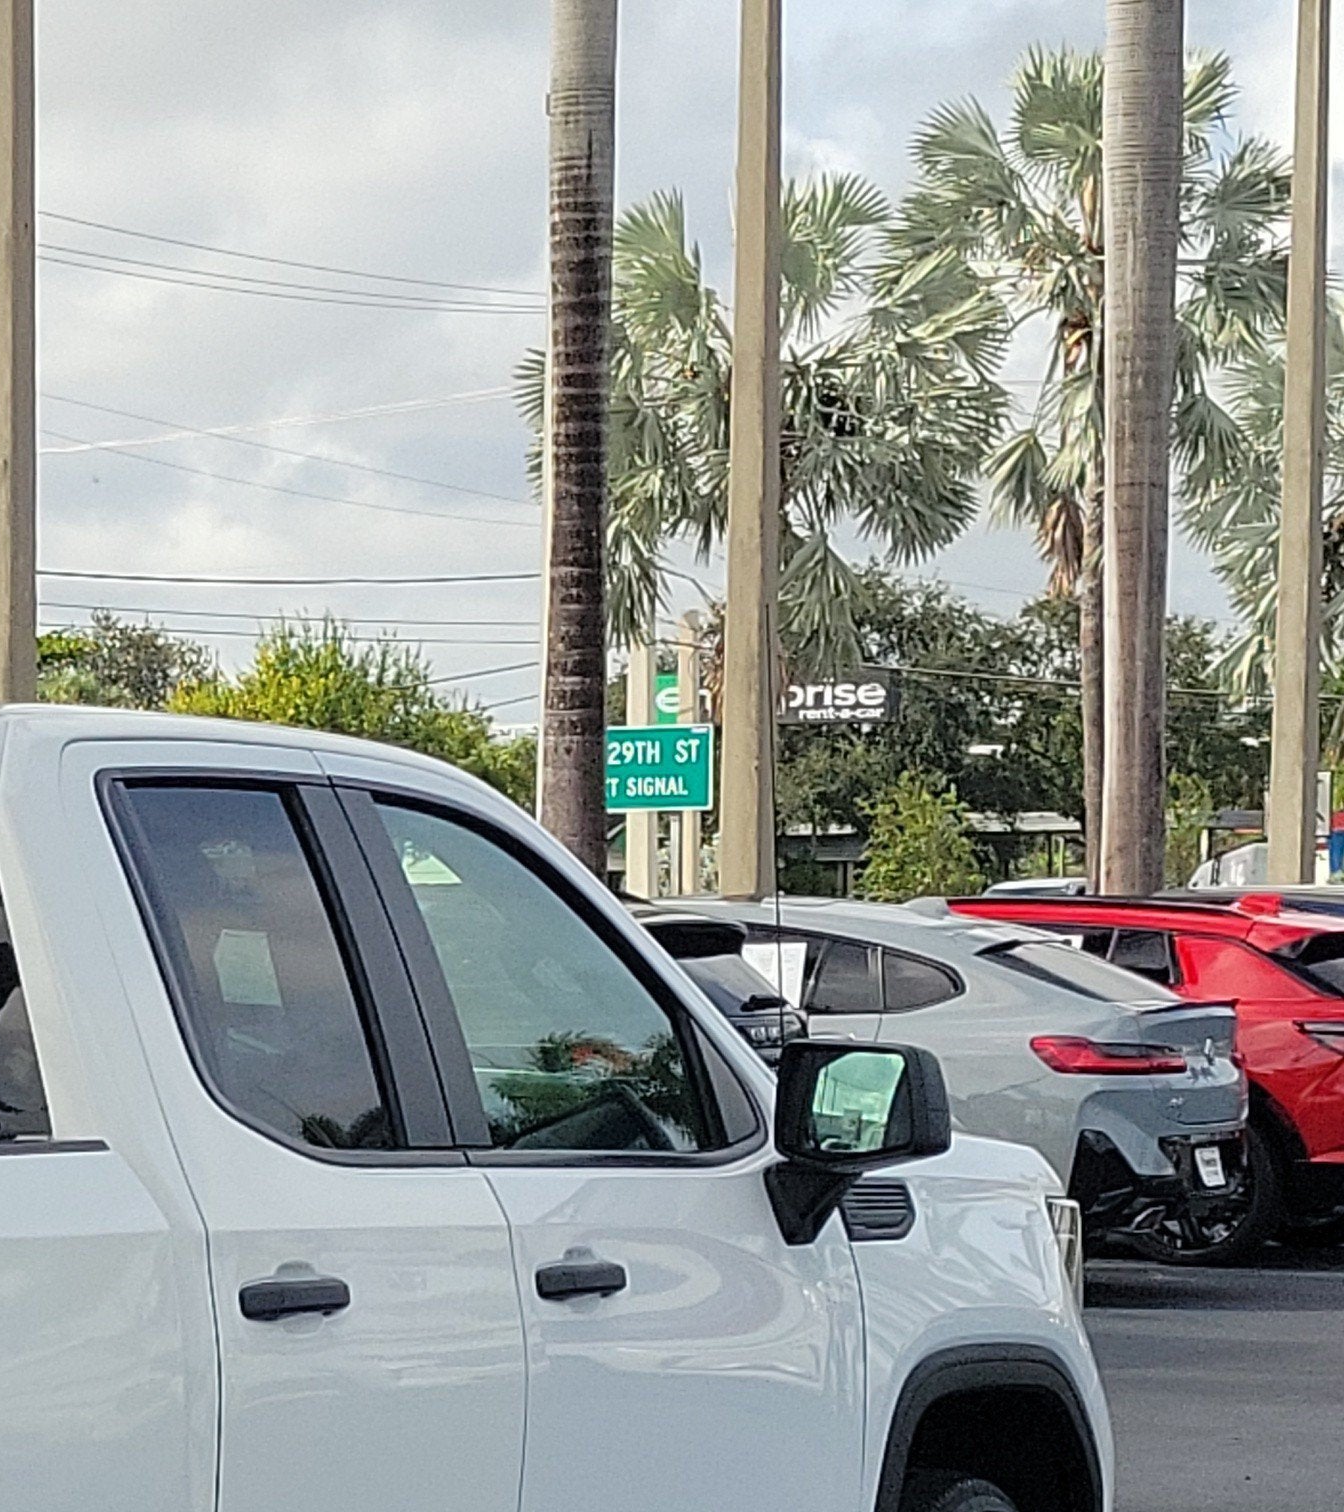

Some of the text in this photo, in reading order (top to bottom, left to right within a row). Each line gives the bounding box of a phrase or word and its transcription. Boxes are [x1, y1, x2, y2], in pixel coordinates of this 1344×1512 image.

[798, 706, 885, 720] rent-a-car
[607, 738, 700, 765] 29TH ST
[625, 776, 689, 797] SIGNAL
